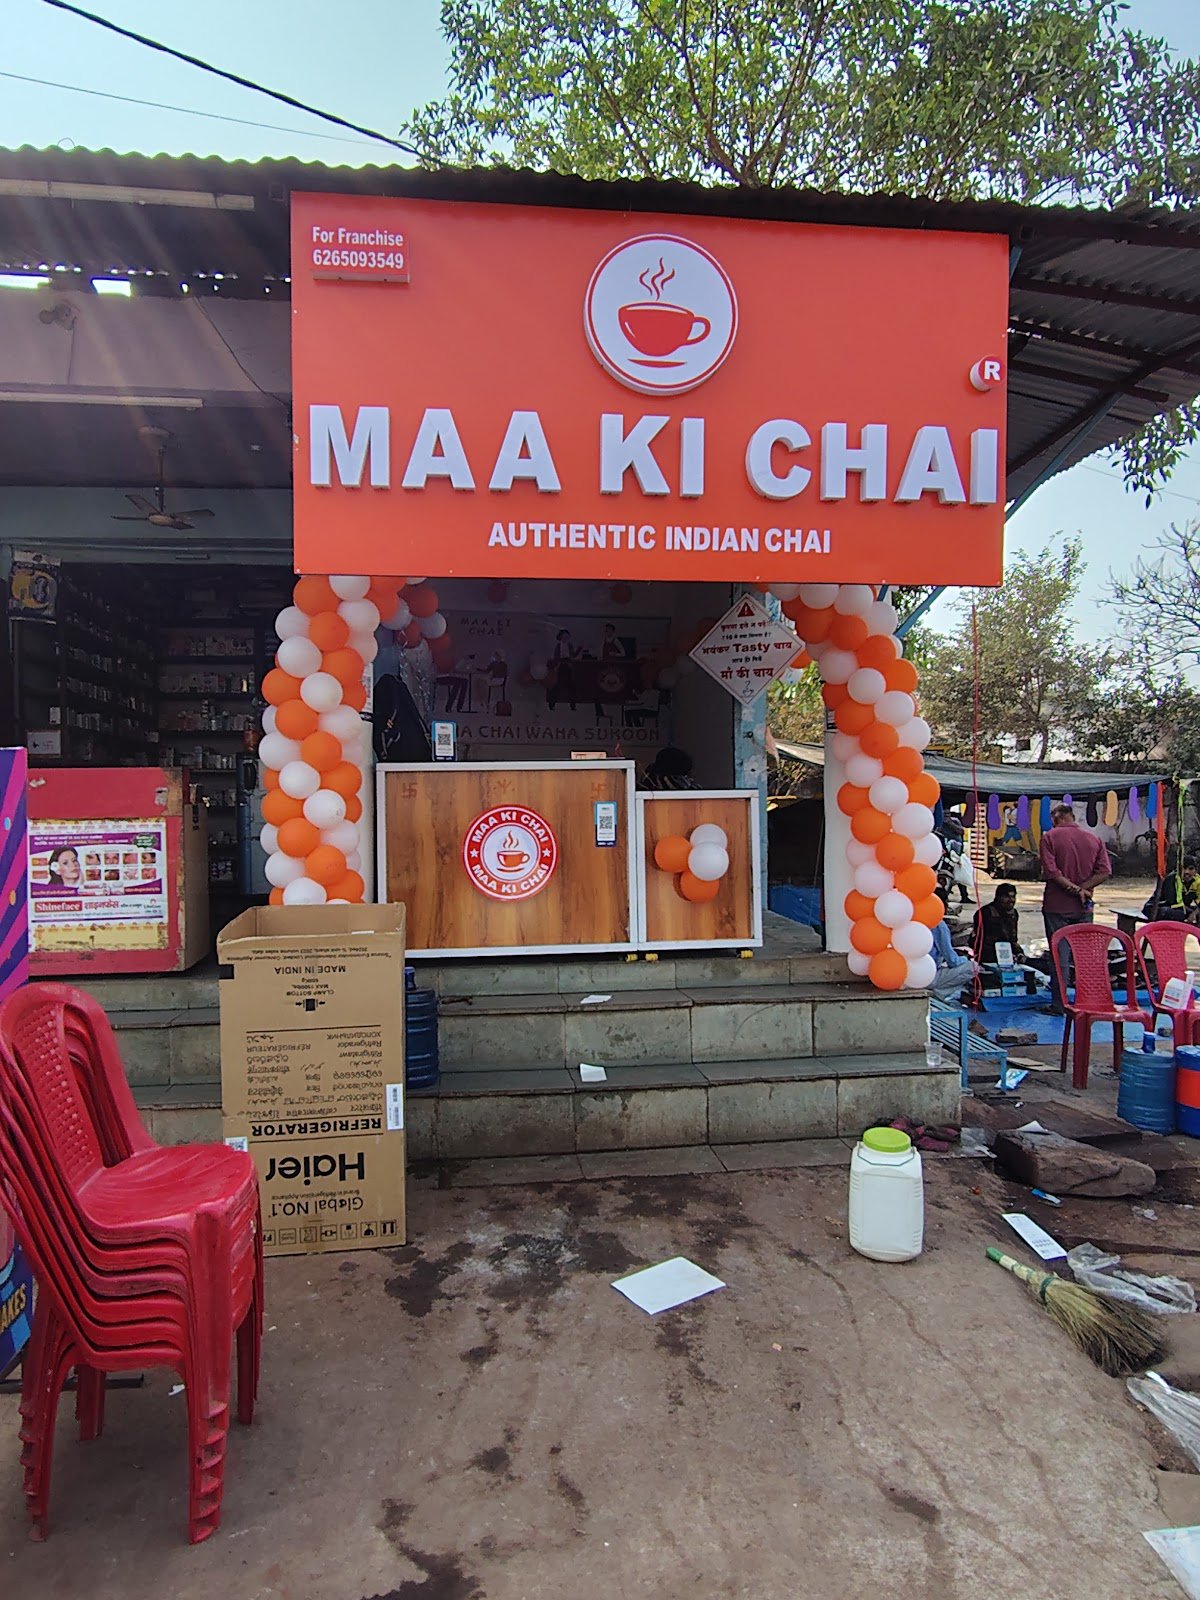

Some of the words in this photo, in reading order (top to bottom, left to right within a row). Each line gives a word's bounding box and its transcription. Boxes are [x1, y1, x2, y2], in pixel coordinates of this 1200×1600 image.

[312, 226, 334, 243] For
[338, 228, 404, 246] Franchise
[313, 249, 404, 269] 6265093549
[308, 404, 562, 494] MAA
[600, 413, 705, 499] KI
[745, 418, 999, 505] CHAI
[488, 522, 656, 549] AUTHENTIC
[665, 526, 759, 552] INDIAN
[764, 528, 831, 554] CHAI
[733, 642, 770, 653] Tasty
[774, 642, 792, 650] चाय
[736, 666, 749, 678] की
[753, 668, 774, 678] चाय
[479, 726, 520, 739] CHAI
[584, 727, 660, 741] SUKOON
[472, 816, 498, 843] MAA
[500, 811, 517, 821] KI
[520, 814, 549, 843] CHAI
[472, 864, 497, 891] MAA
[501, 884, 517, 893] KI
[520, 863, 549, 891] CHAI
[36, 902, 80, 912] Shineface
[274, 967, 302, 975] INDIA
[305, 966, 315, 974] IN
[318, 965, 346, 973] MADE
[252, 1118, 381, 1137] REFRIGERATOR
[265, 1152, 365, 1186] Haier
[315, 1197, 364, 1214] Global
